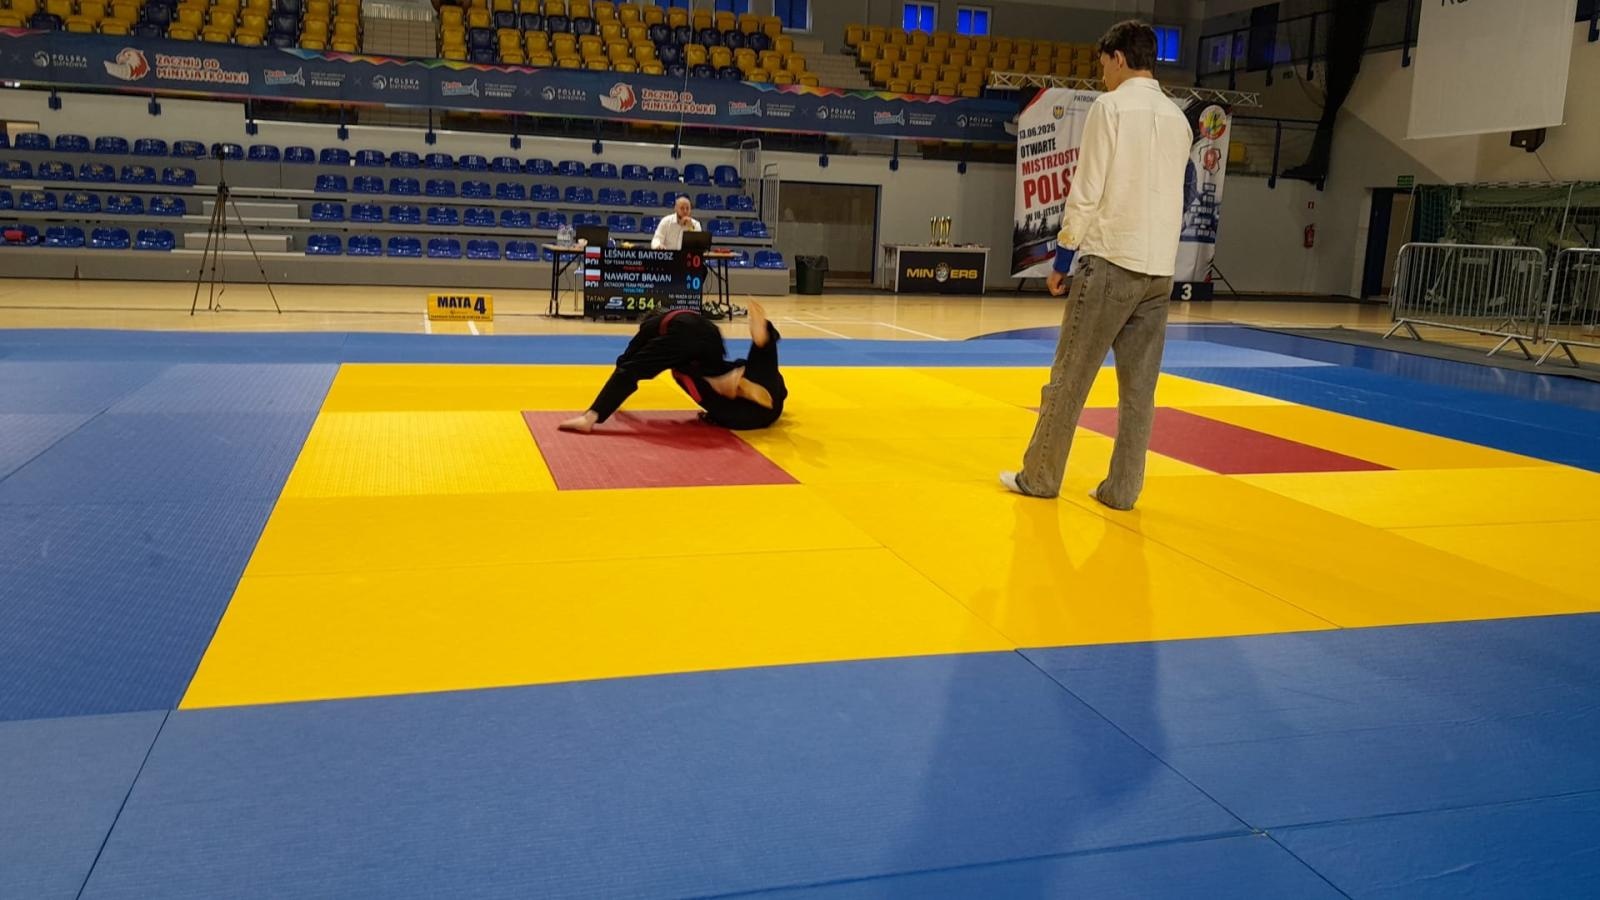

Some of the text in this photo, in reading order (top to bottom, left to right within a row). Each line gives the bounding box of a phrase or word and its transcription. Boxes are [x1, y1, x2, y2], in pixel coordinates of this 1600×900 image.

[52, 54, 87, 62] POLSKA
[156, 54, 220, 69] ZACZNIJ OD
[389, 77, 419, 85] POLSKA
[557, 88, 586, 96] POLSKA
[641, 88, 694, 103] ZACZNIJ OD
[1073, 95, 1096, 103] PATRON
[1020, 137, 1056, 159] OTWARTE
[1023, 165, 1077, 209] POLS
[604, 248, 674, 260] LEŚNIAK BARTOSZ
[693, 255, 701, 268] 0
[604, 272, 672, 282] NAWROT BRAJAN
[906, 268, 934, 278] MIN
[692, 277, 701, 290] 0
[1181, 283, 1192, 300] 3
[437, 296, 486, 314] MATA 4
